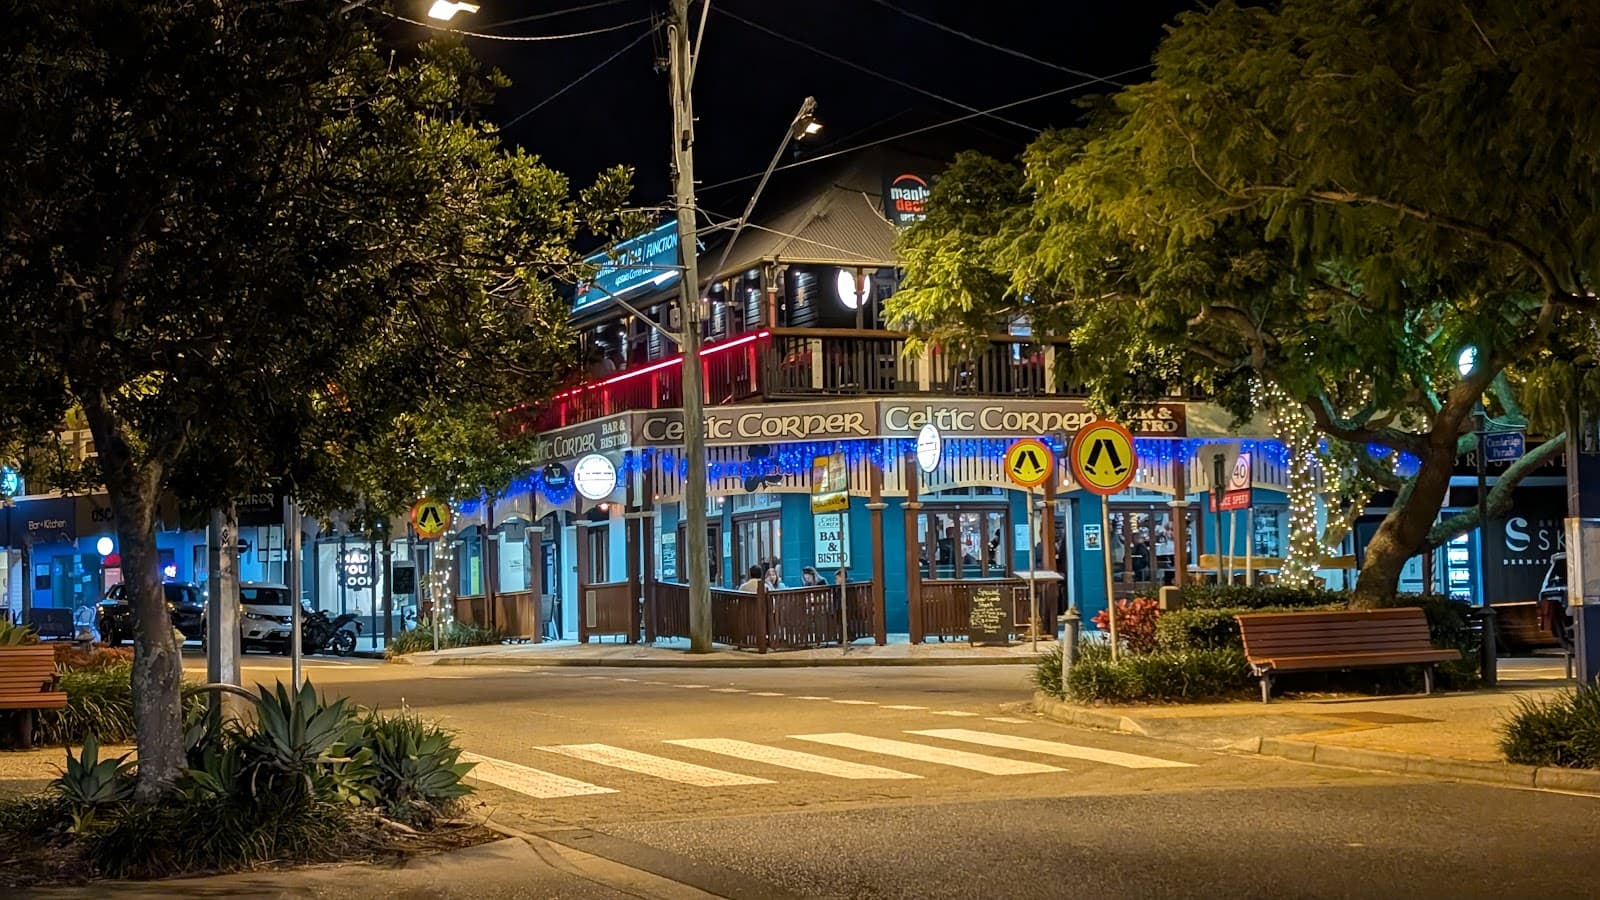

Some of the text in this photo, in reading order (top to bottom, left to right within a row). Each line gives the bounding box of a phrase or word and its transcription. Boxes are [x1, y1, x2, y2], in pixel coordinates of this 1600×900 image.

[646, 232, 678, 259] FUNCTION
[885, 406, 975, 432] Celtic
[1157, 407, 1173, 419] &
[602, 419, 626, 435] BAR &
[737, 412, 870, 439] Corner
[554, 433, 597, 458] Corner
[600, 433, 628, 450] BISTRO
[1233, 464, 1246, 479] 40
[827, 542, 838, 551] &
